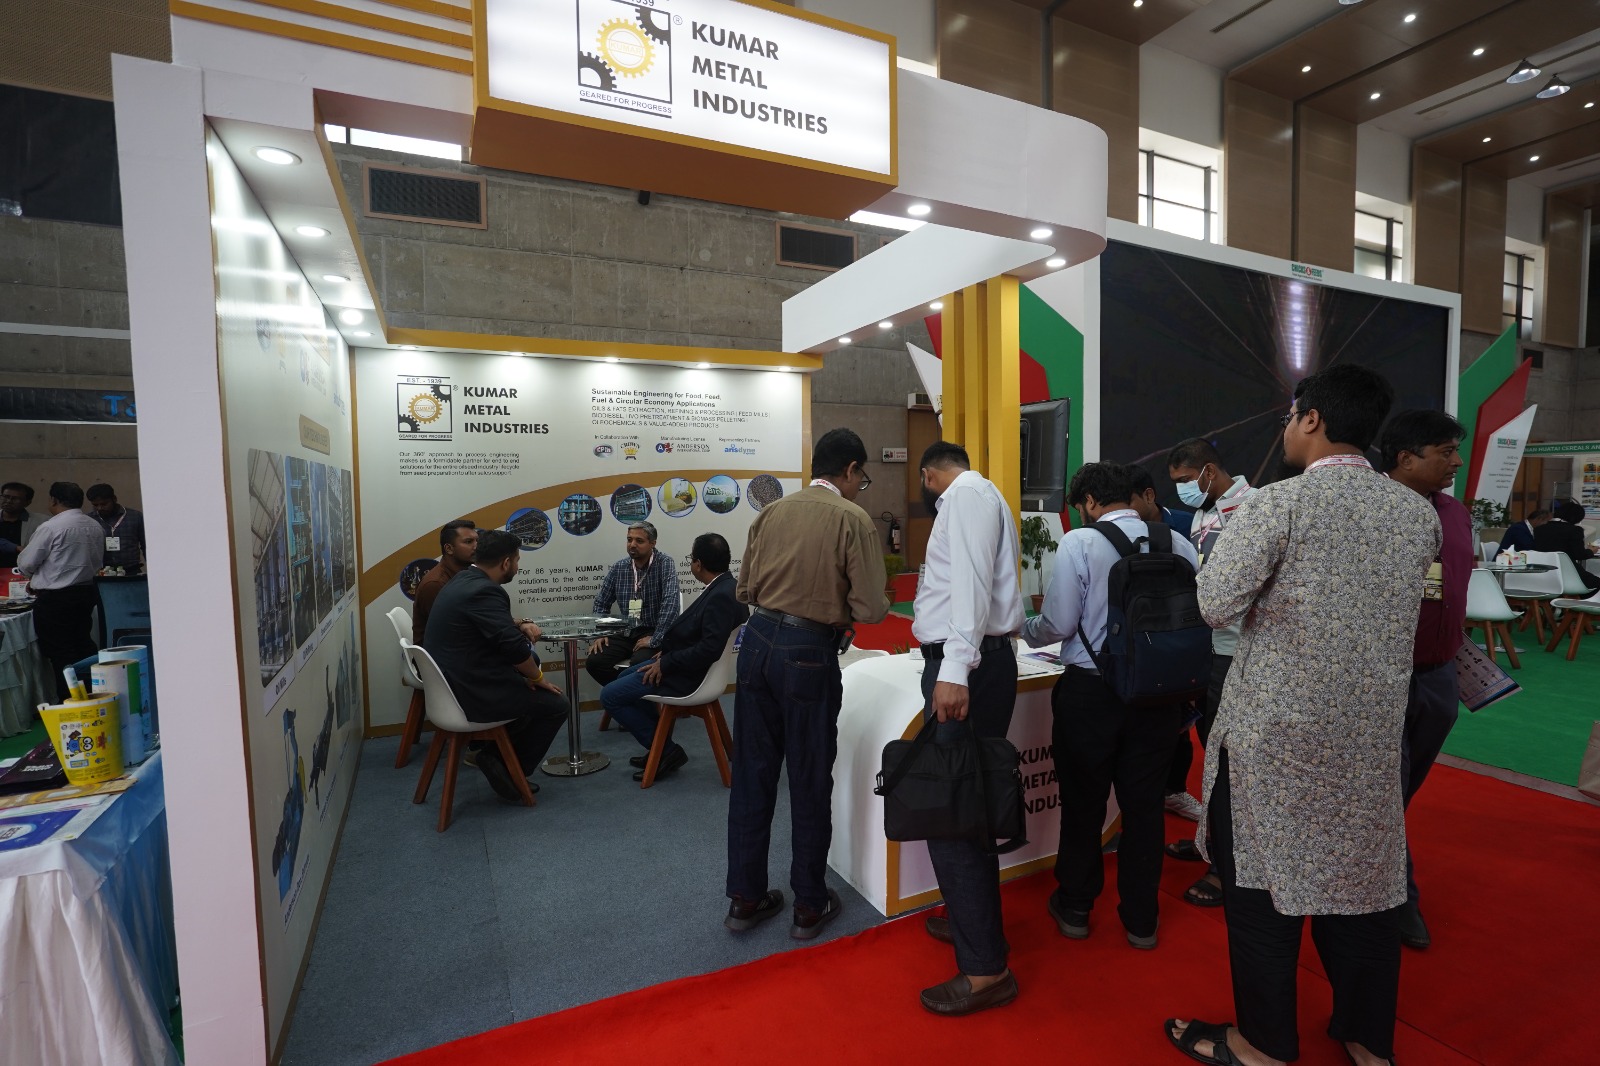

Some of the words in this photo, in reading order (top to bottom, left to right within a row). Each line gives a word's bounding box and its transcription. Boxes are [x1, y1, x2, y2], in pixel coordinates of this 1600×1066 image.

[692, 20, 779, 60] KUMAR
[610, 40, 643, 54] KUMAR
[691, 55, 768, 90] METAL
[579, 89, 612, 102] GEARED
[613, 96, 630, 106] FOR
[631, 99, 672, 114] PROGRESS
[693, 89, 828, 135] INDUSTRIES
[464, 386, 518, 398] KUMAR
[591, 388, 632, 396] Sustainable
[633, 389, 673, 399] Engineering
[615, 397, 642, 405] Circular
[643, 399, 674, 407] Economy
[676, 400, 715, 408] Applications
[464, 404, 511, 416] METAL
[464, 422, 550, 434] INDUSTRIES
[575, 565, 604, 573] KUMAR
[518, 576, 549, 584] solutions
[518, 586, 547, 595] versatile
[548, 585, 562, 593] and
[541, 595, 573, 603] countries
